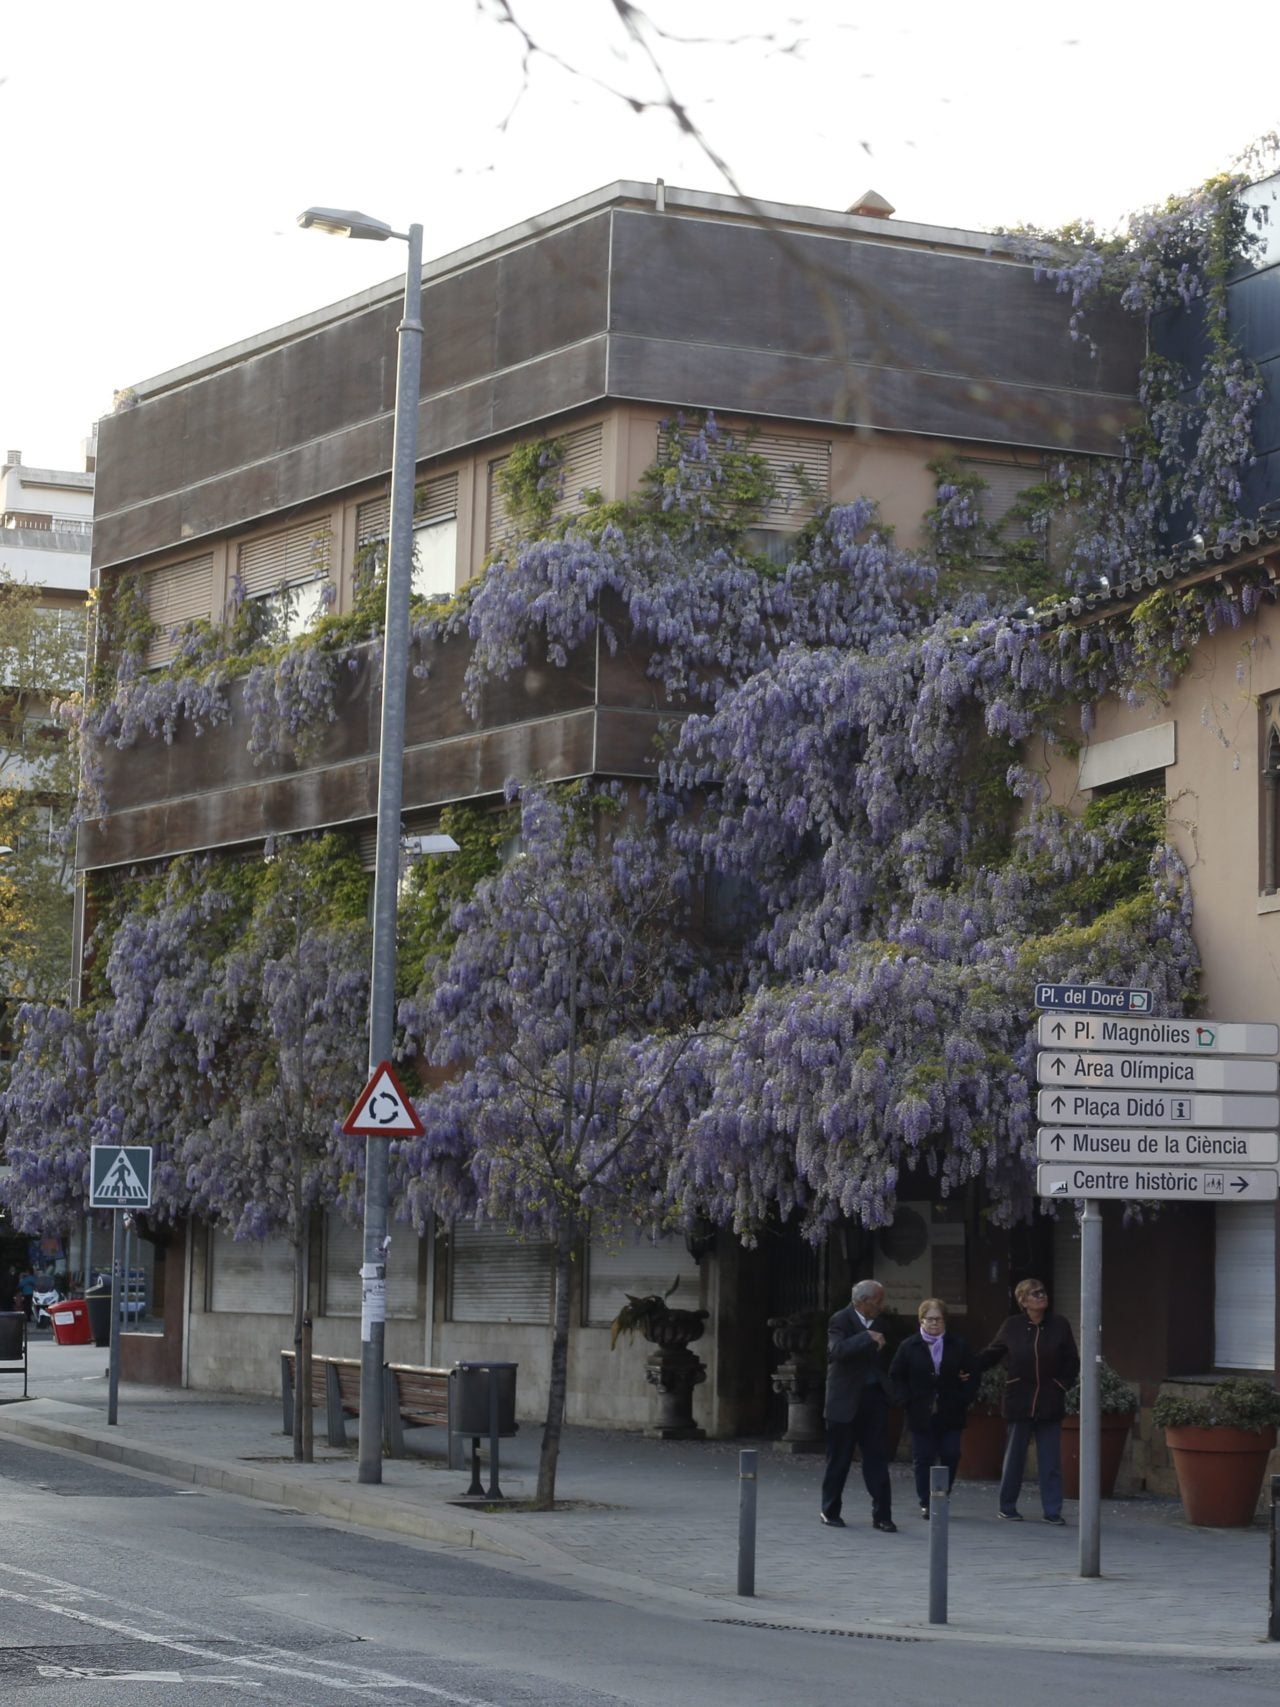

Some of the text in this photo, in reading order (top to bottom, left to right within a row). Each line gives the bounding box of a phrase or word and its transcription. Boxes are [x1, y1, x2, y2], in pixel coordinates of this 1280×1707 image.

[1041, 987, 1125, 1007] Pl. del Doré
[1074, 1021, 1190, 1046] Pl. Magnòlies
[1074, 1055, 1195, 1083] Àrea Olímpica
[1073, 1097, 1121, 1119] Plaça
[1127, 1098, 1165, 1118] Didó
[1073, 1133, 1247, 1155] Museu de la Ciència
[1073, 1170, 1198, 1191] Centre històric
